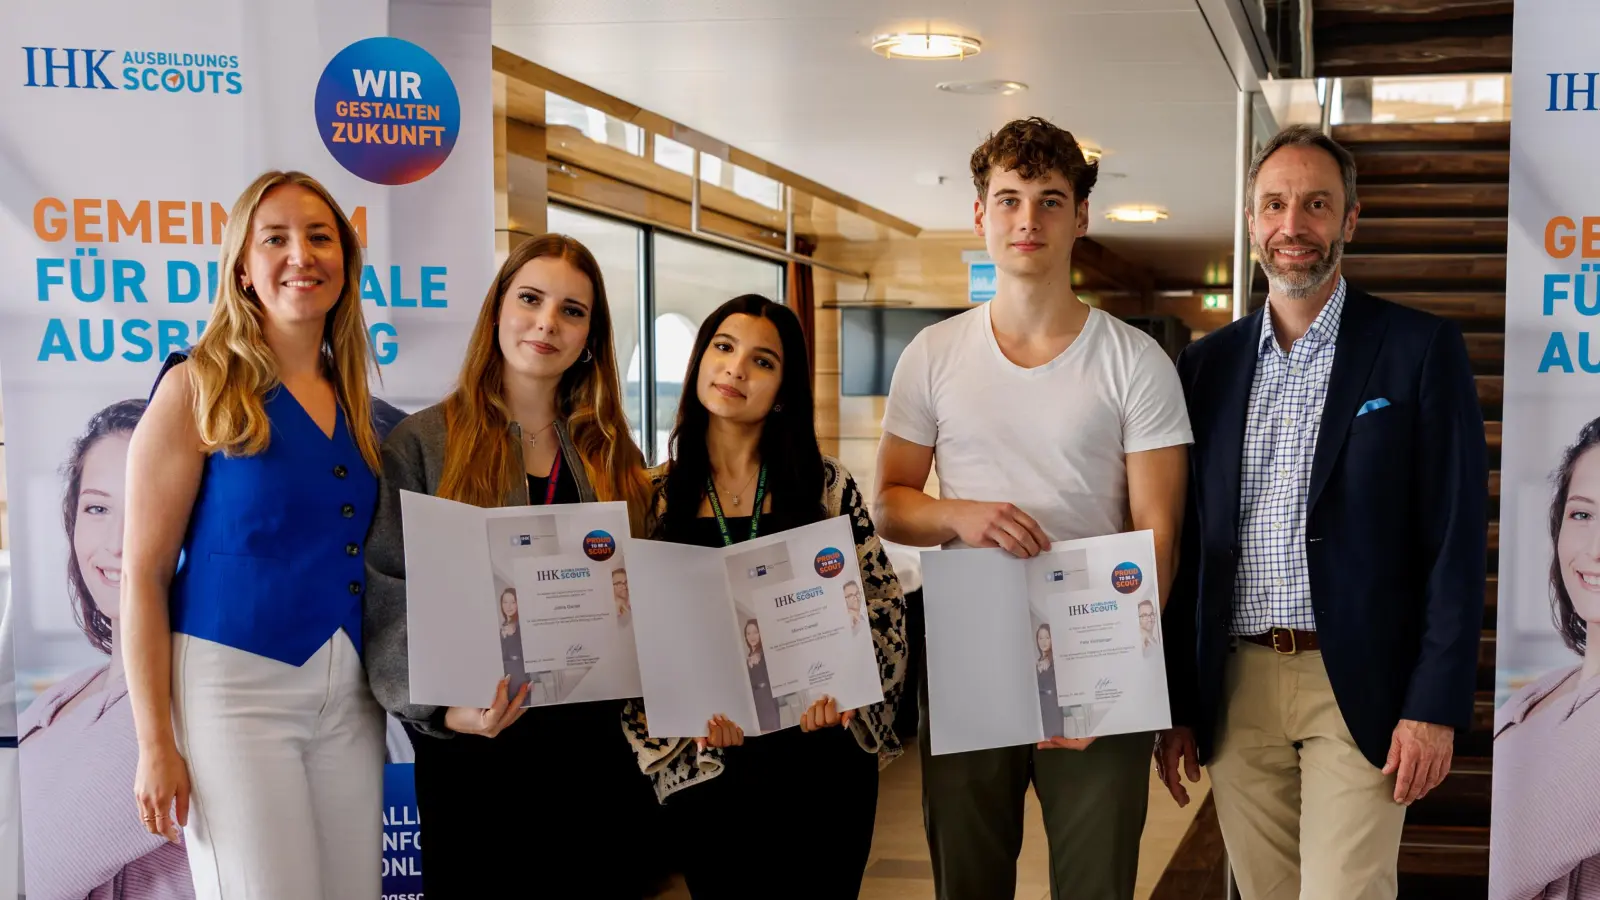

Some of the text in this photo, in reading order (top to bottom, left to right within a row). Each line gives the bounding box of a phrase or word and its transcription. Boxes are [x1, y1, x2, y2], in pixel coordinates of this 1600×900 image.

[22, 46, 118, 90] IHK
[122, 51, 239, 69] AUSBILDUNGS
[122, 68, 243, 95] SCOUTS
[352, 69, 422, 99] WIR
[1545, 72, 1600, 112] IH
[336, 101, 441, 121] GESTALTEN
[332, 122, 446, 147] ZUKUNFT
[1544, 215, 1600, 260] GE
[36, 248, 449, 309] FÜR DI ALE
[1543, 263, 1600, 316] FÜ
[1537, 331, 1600, 374] AU
[817, 552, 840, 563] PROUD
[537, 569, 560, 581] IHK
[561, 571, 591, 579] SCOUTS
[820, 563, 841, 573] SCOUT
[1114, 568, 1139, 577] PROUD
[1116, 579, 1139, 588] SCOUT
[774, 593, 797, 608] IHK
[796, 589, 824, 601] SCOUTS
[1068, 604, 1090, 616] IHK
[1090, 604, 1118, 613] SCOUTS
